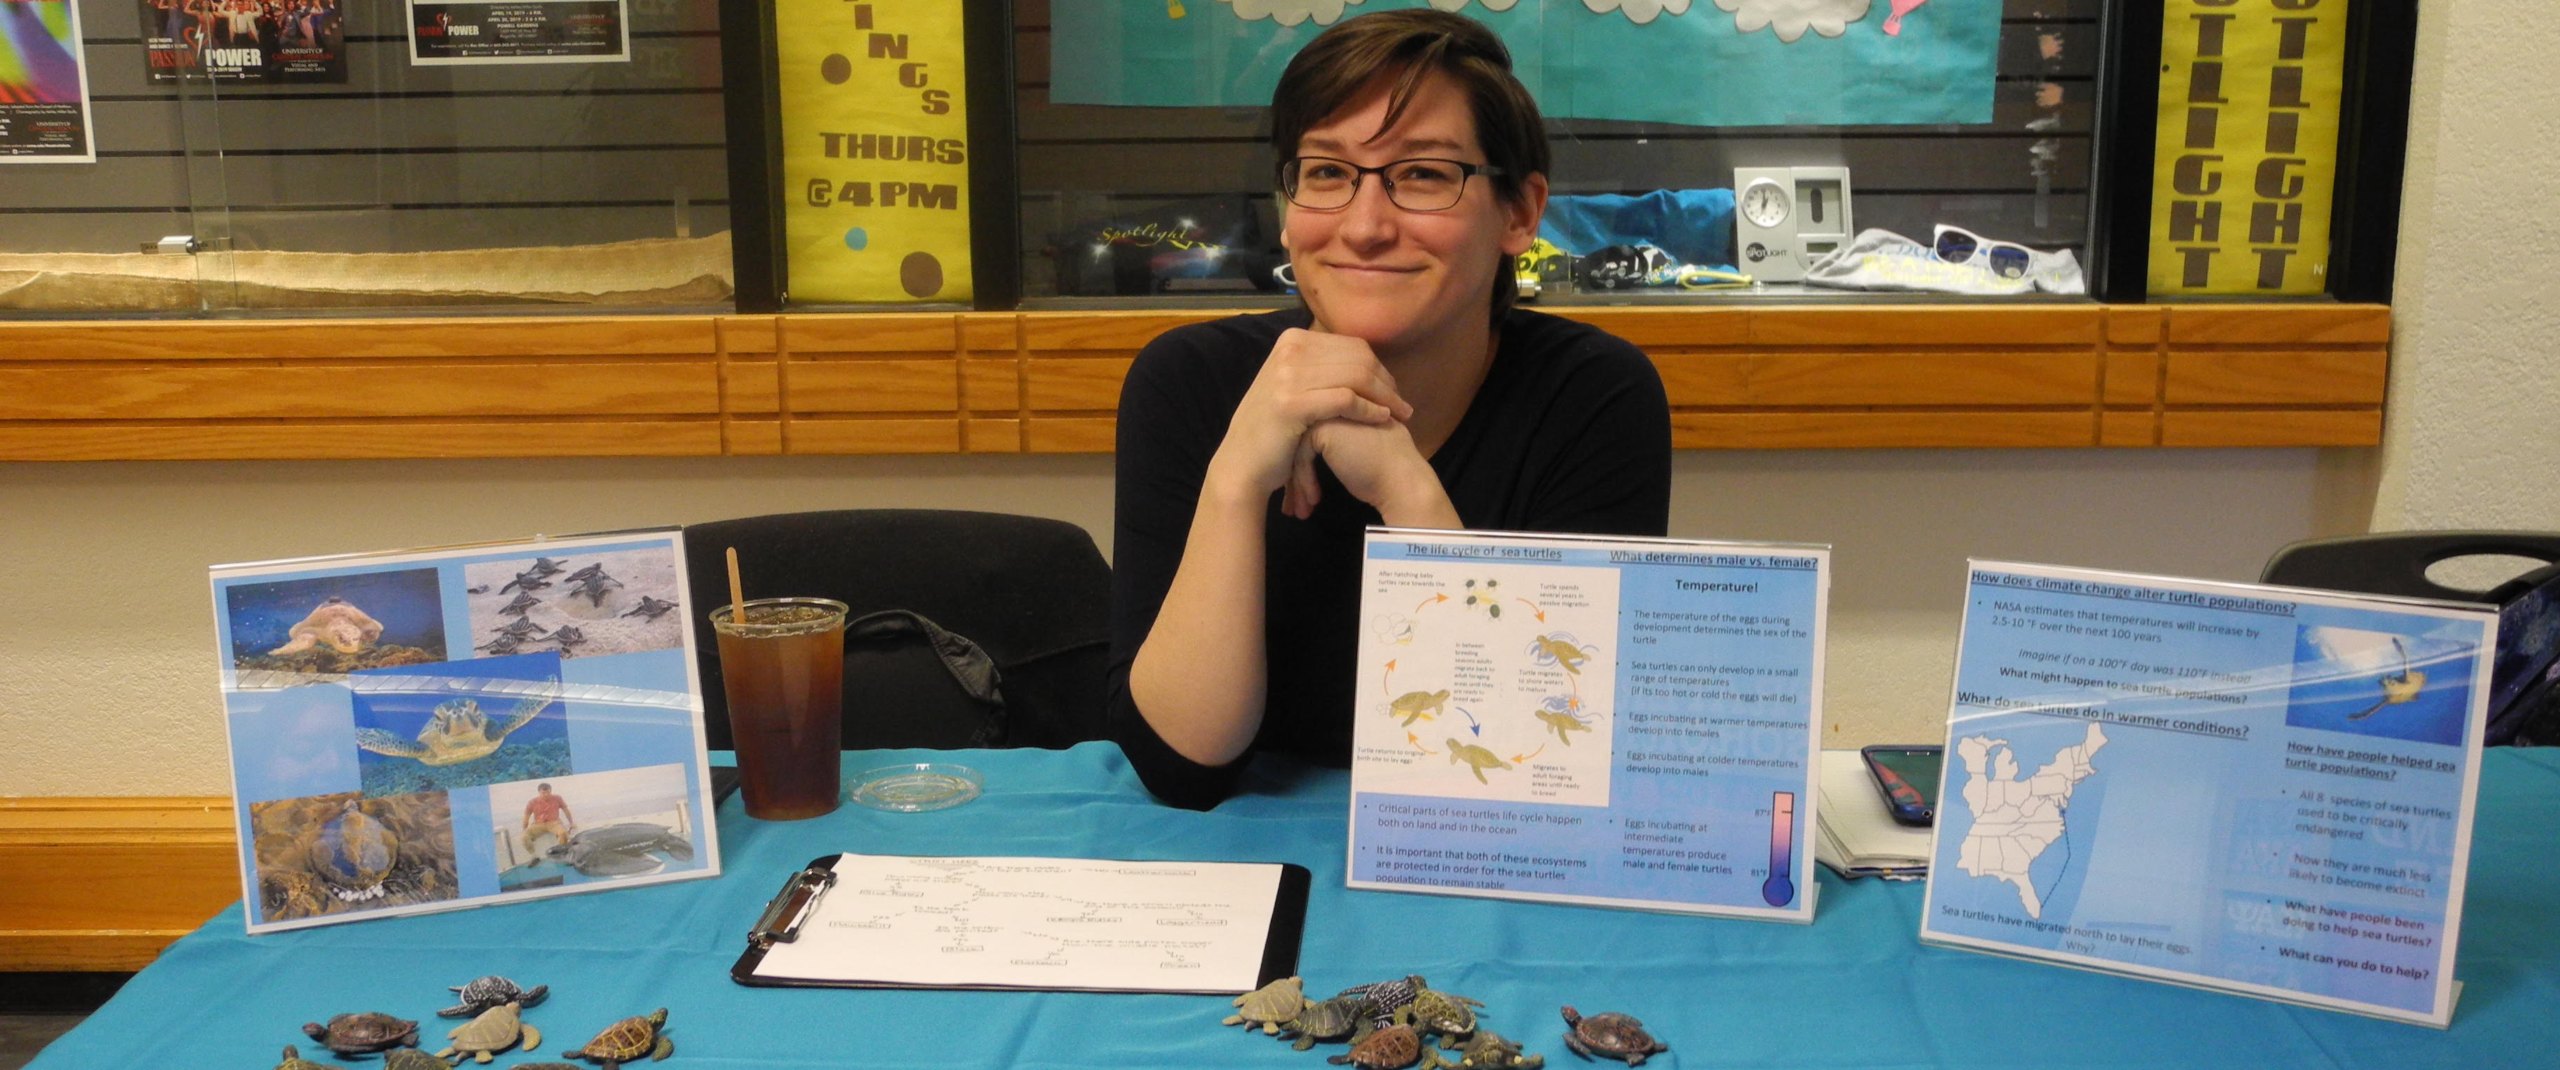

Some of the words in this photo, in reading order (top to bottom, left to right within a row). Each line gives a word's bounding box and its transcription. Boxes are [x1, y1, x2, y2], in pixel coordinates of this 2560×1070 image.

[205, 49, 262, 66] POWER
[819, 132, 964, 165] THURS
[2168, 0, 2236, 288] TLIGHT
[2248, 0, 2320, 289] TLIGHT
[1098, 222, 1187, 249] Spotlight
[1406, 543, 1429, 554] The
[1431, 544, 1450, 555] life
[1452, 545, 1481, 558] cycle
[1483, 546, 1496, 556] of
[1501, 549, 1521, 557] sea
[1524, 547, 1562, 558] turtles
[1610, 550, 1644, 562] What
[1646, 550, 1715, 564] determines
[1717, 553, 1748, 565] male
[1750, 557, 1767, 566] vs.
[1769, 555, 1818, 567] female?
[1676, 579, 1758, 593] Temperature!
[1971, 572, 2001, 585] How
[2003, 574, 2034, 588] does
[2037, 578, 2085, 593] climate
[2087, 582, 2134, 599] change
[2170, 590, 2208, 604] turtle
[2210, 596, 2297, 613] populations?
[1634, 610, 1651, 618] The
[1652, 611, 1709, 621] temperature
[1710, 612, 1720, 621] of
[1722, 613, 1737, 622] the
[1739, 616, 1759, 624] eggs
[1761, 614, 1790, 625] during
[1994, 602, 2023, 613] NASA
[2025, 606, 2076, 619] estimates
[2078, 610, 2100, 621] that
[2102, 612, 2174, 628] temperatures
[2176, 620, 2196, 630] will
[2198, 621, 2243, 635] increase
[2245, 626, 2260, 639] by
[1633, 622, 1692, 634] development
[1694, 625, 1744, 635] determines
[1746, 627, 1761, 636] the
[1779, 629, 1789, 637] of
[1791, 629, 1806, 638] the
[1633, 636, 1657, 644] turtle
[2039, 623, 2063, 632] over
[2065, 623, 2083, 634] the
[2085, 627, 2109, 636] next
[2110, 628, 2131, 638] 100
[2133, 632, 2162, 642] years
[1999, 667, 2029, 679] What
[2031, 670, 2062, 683] might
[2064, 673, 2105, 688] happen
[2107, 679, 2119, 689] to
[2142, 682, 2173, 695] turtle
[2175, 688, 2247, 703] populations?
[1957, 693, 1992, 707] What
[1994, 696, 2012, 709] do
[2084, 706, 2101, 719] do
[2104, 708, 2117, 721] in
[2119, 714, 2171, 727] warmer
[2173, 719, 2250, 736] conditions?
[2287, 740, 2315, 753] How
[2317, 743, 2346, 757] have
[2348, 750, 2389, 763] people
[2391, 752, 2432, 768] helped
[2435, 761, 2455, 771] sea
[2285, 757, 2318, 770] turtle
[2320, 763, 2396, 779] populations?
[1378, 804, 1412, 814] Critical
[1413, 807, 1438, 816] parts
[1440, 807, 1450, 816] of
[1452, 810, 1468, 818] sea
[1470, 809, 1502, 819] turtles
[1503, 811, 1519, 820] life
[1520, 812, 1544, 823] cycle
[1546, 813, 1582, 825] happen
[1378, 818, 1401, 828] both
[1417, 820, 1438, 830] land
[1439, 822, 1458, 831] and
[1459, 823, 1469, 832] in
[1470, 823, 1487, 833] the
[1376, 846, 1384, 854] It
[1386, 846, 1394, 855] is
[1396, 846, 1444, 858] important
[1445, 850, 1466, 860] that
[1467, 851, 1490, 861] both
[1492, 853, 1502, 862] of
[1504, 853, 1531, 864] these
[1533, 857, 1587, 867] ecosystems
[1376, 874, 1427, 884] population
[1428, 876, 1439, 885] to
[1441, 878, 1474, 887] remain
[1476, 879, 1505, 888] stable
[1394, 862, 1440, 872] protected
[1442, 863, 1452, 872] in
[1453, 865, 1480, 874] order
[1482, 866, 1496, 875] for
[1498, 867, 1514, 876] the
[1516, 870, 1532, 878] sea
[1534, 870, 1566, 880] turtles
[1942, 905, 1960, 917] Sea
[1962, 909, 1997, 922] turtles
[1998, 914, 2024, 926] have
[2026, 919, 2072, 934] migrated
[2074, 928, 2104, 939] north
[2106, 931, 2118, 941] to
[2120, 932, 2136, 946] lay
[2137, 936, 2163, 948] their
[2279, 947, 2312, 961] What
[2314, 954, 2335, 964] can
[2337, 958, 2360, 968] you
[2362, 958, 2378, 971] do
[2380, 962, 2394, 973] to
[2396, 964, 2429, 980] help?
